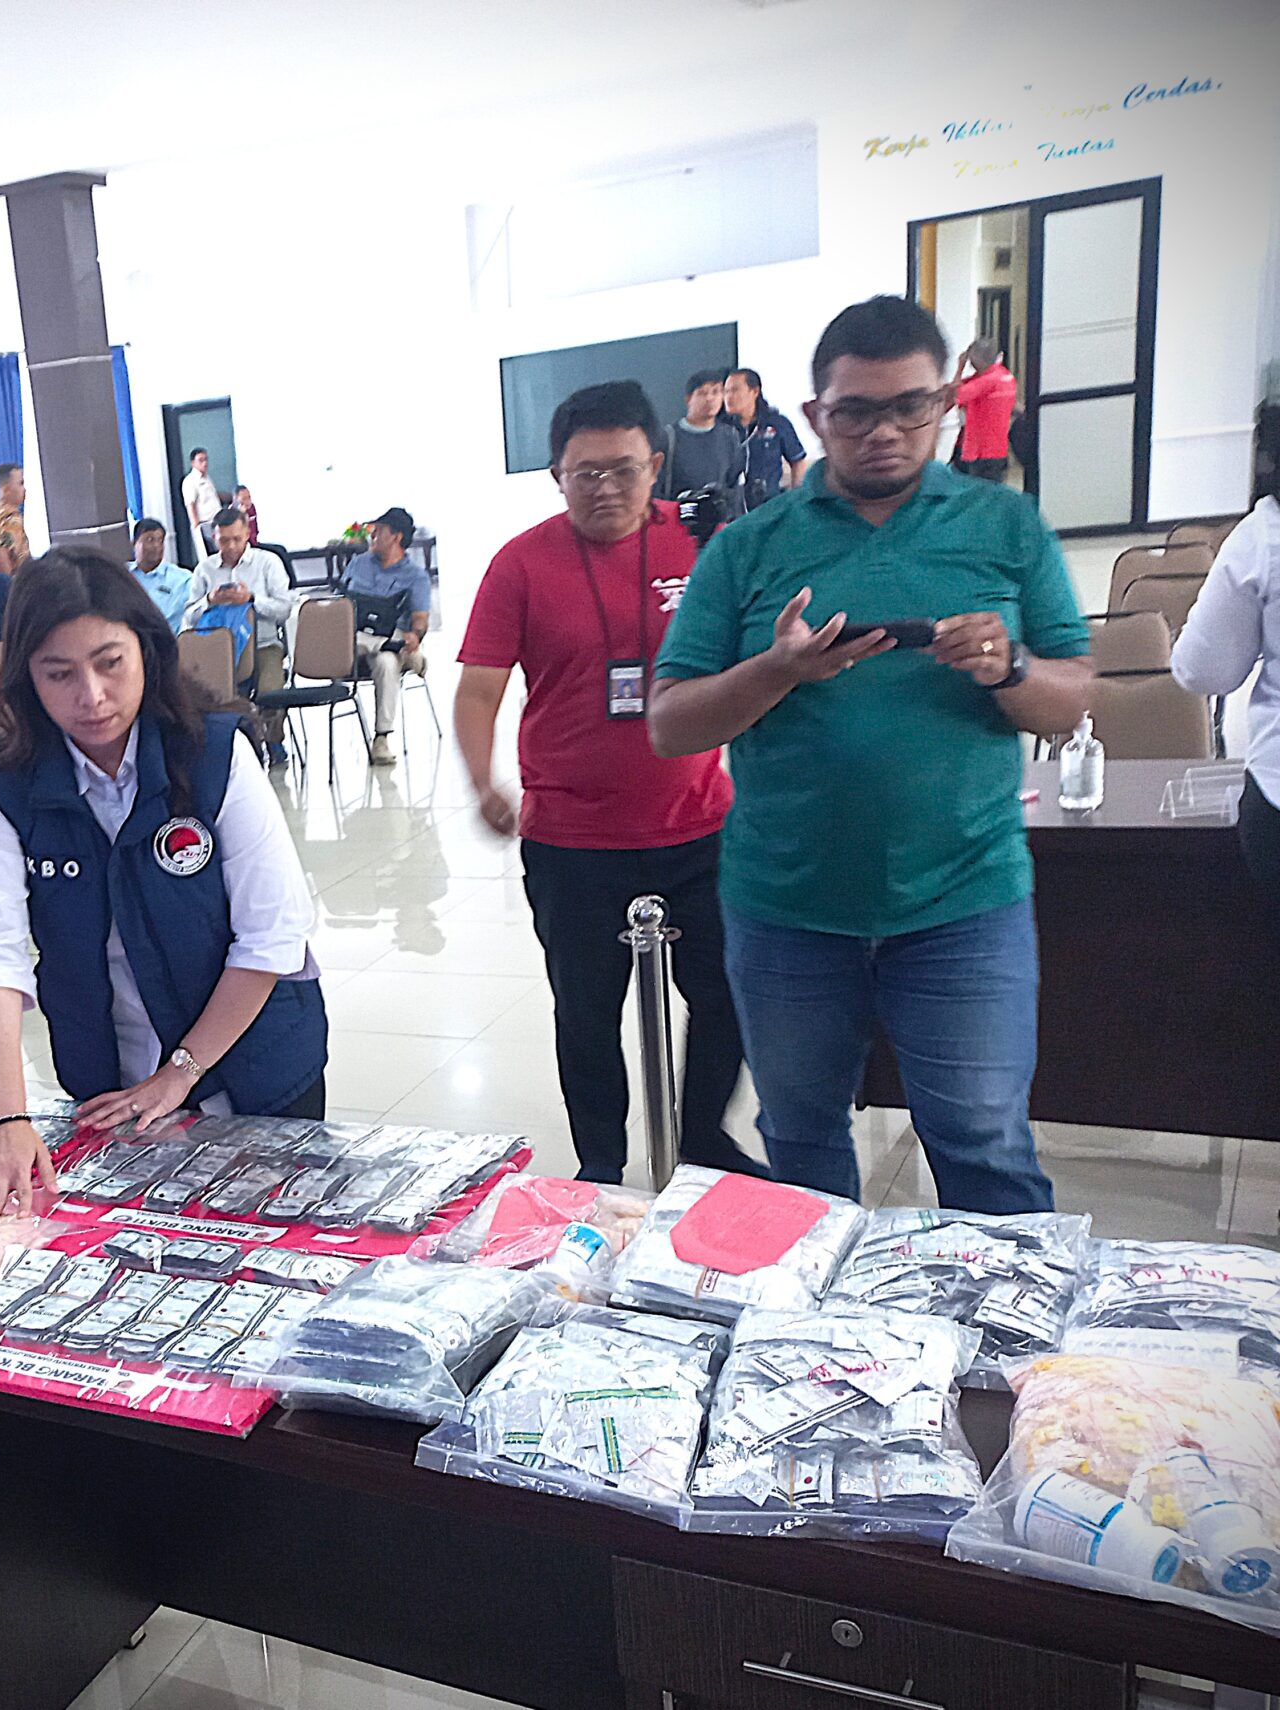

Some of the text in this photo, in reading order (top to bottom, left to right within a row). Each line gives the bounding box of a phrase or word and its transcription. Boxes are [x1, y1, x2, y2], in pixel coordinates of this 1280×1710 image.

[133, 1217, 181, 1229] BUKTI
[181, 1223, 250, 1239] BARANG
[34, 1365, 109, 1388] BARANG
